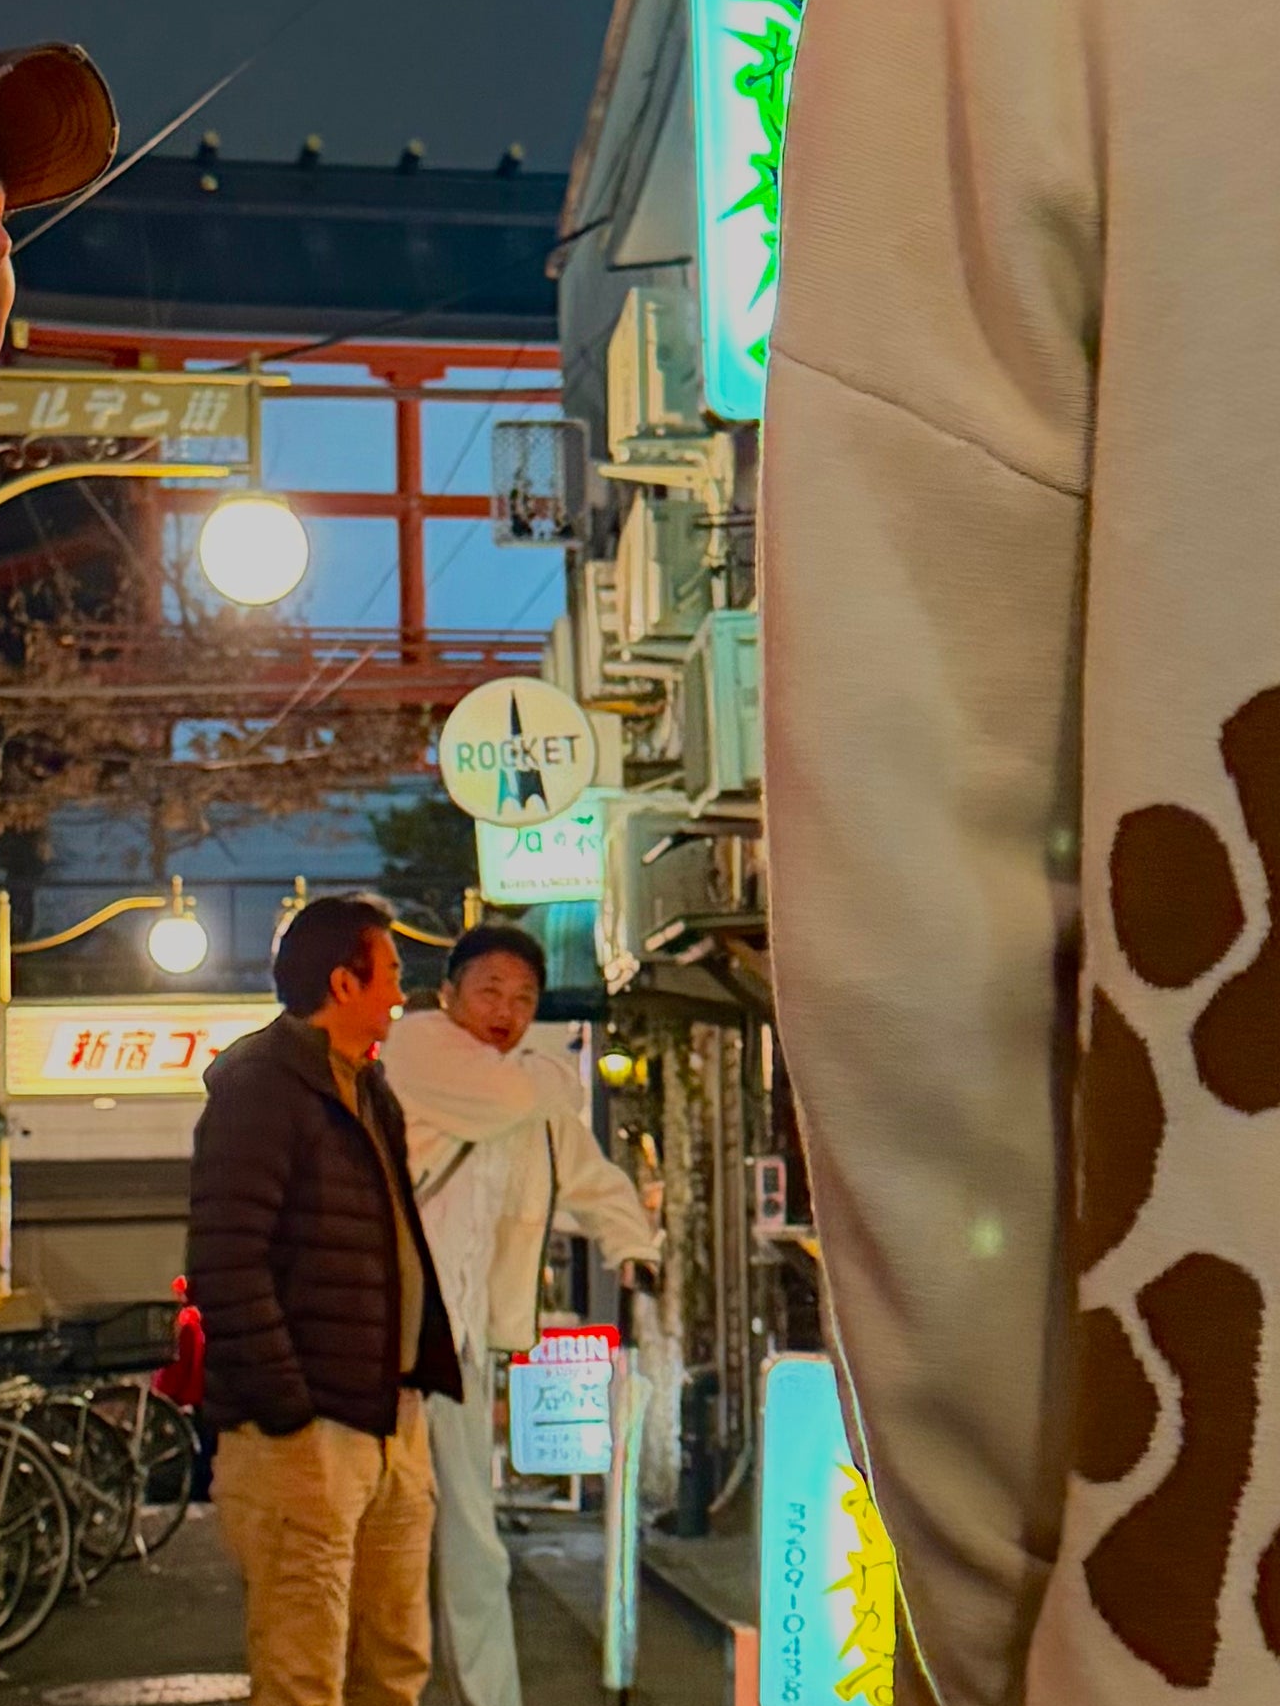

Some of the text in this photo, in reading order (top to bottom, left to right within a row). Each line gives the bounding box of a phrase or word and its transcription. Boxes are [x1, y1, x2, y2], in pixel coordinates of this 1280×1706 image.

[455, 734, 581, 774] ROCKET
[68, 1029, 219, 1071] 新宿ゴ
